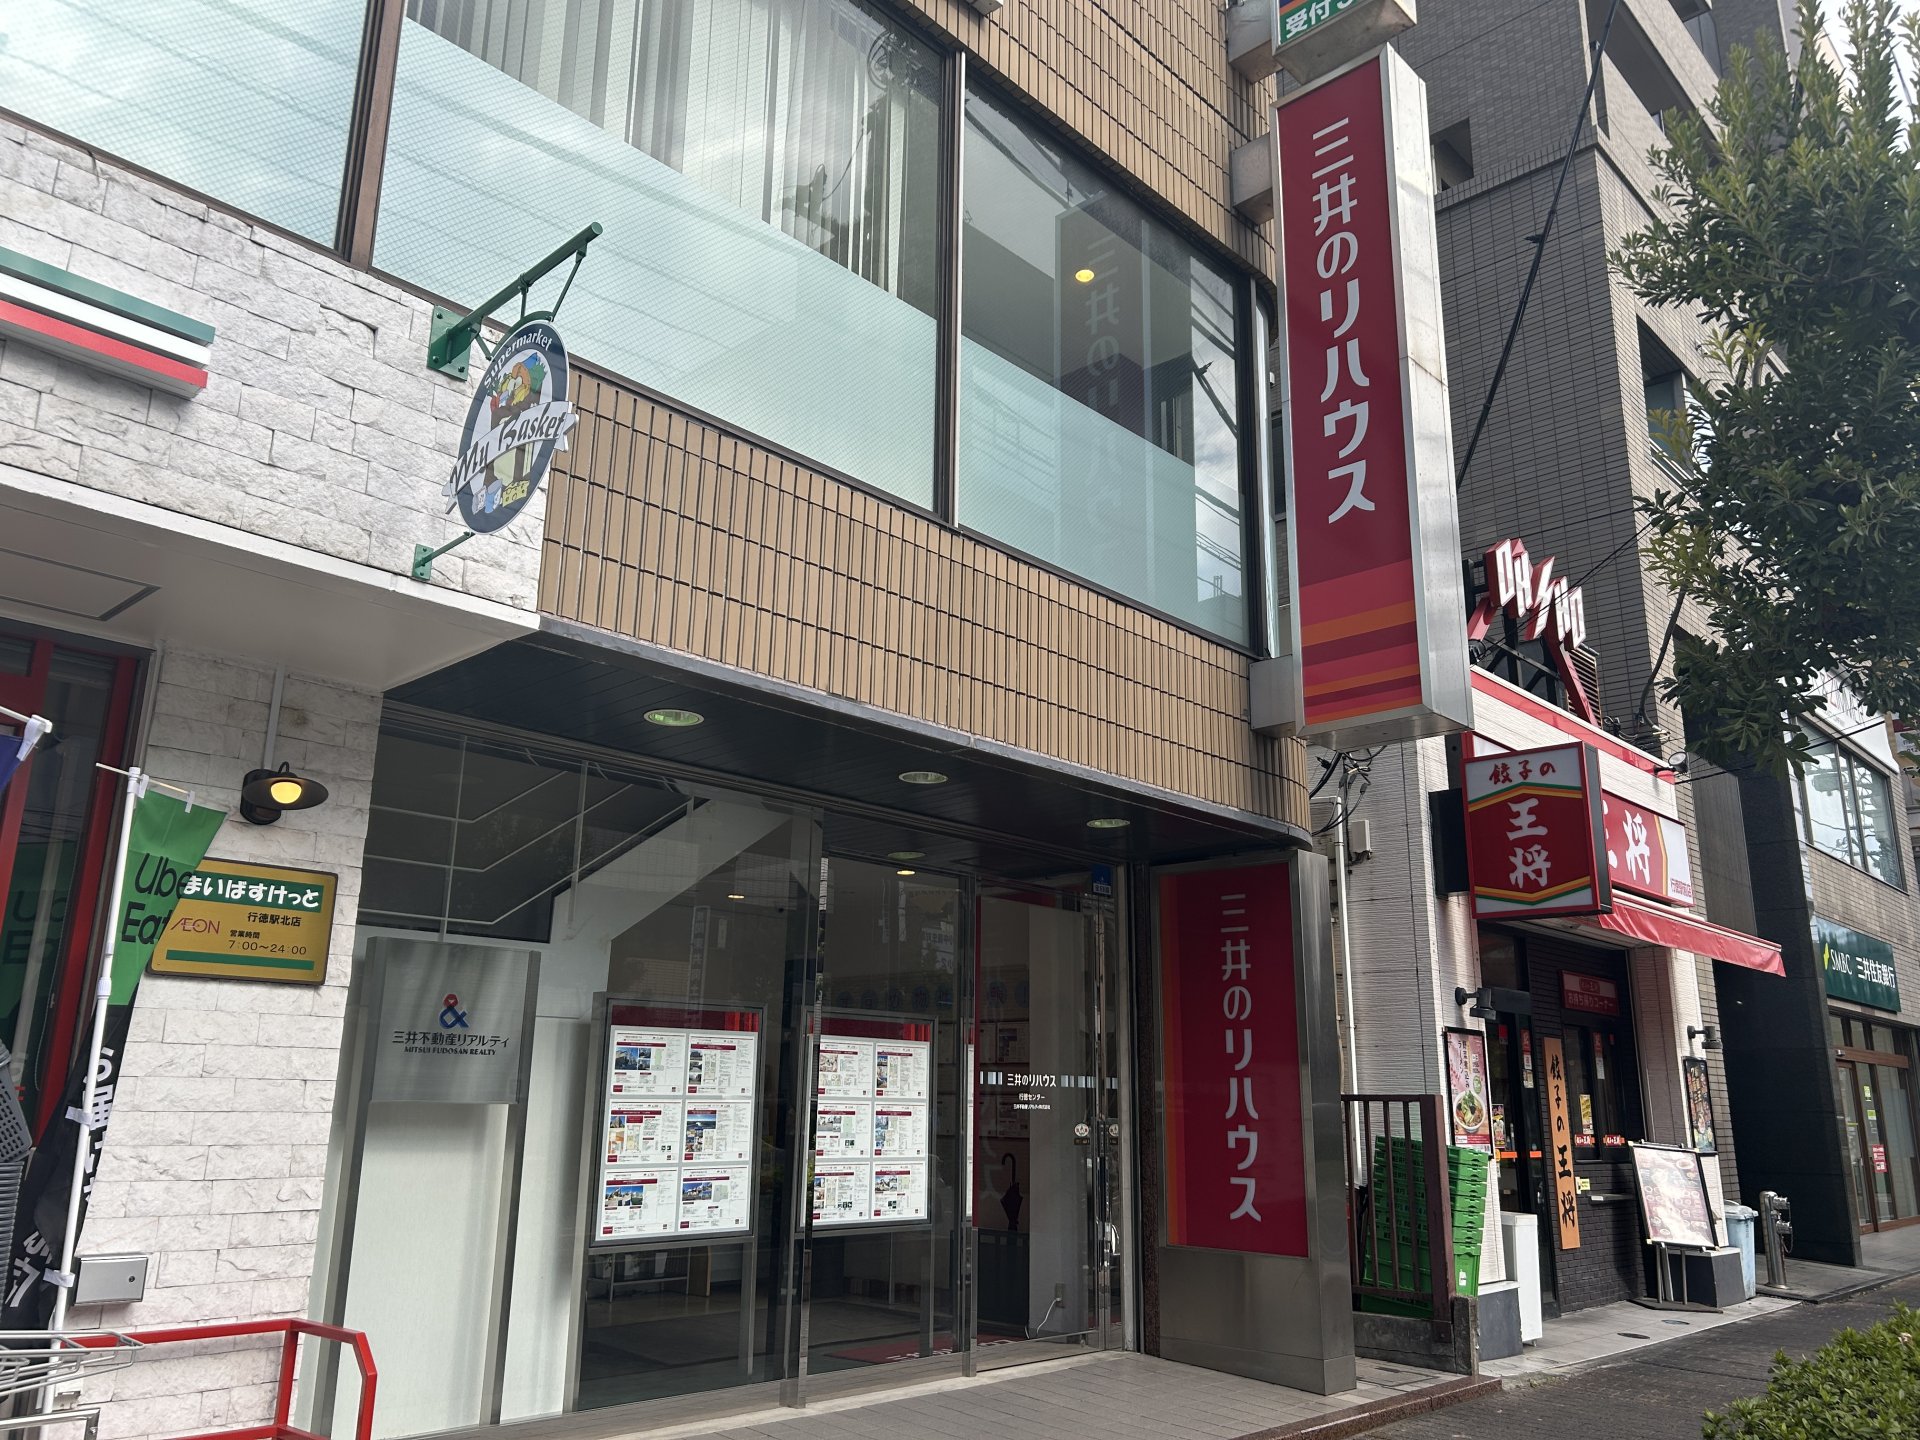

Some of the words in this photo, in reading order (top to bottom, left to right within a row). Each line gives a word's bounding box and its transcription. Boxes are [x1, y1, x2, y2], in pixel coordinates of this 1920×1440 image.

[1312, 117, 1375, 524] 三井のリハウス
[484, 328, 553, 389] Supermarket
[450, 440, 490, 492] My
[499, 401, 567, 451] Basket
[1489, 759, 1556, 785] 餃子の
[1506, 797, 1552, 889] 王将
[183, 875, 320, 908] まいばすけっと
[229, 929, 260, 939] 営業時間
[247, 911, 302, 927] 行徳駅北店
[1830, 949, 1853, 975] SMBC
[1856, 956, 1896, 989] 三井住友銀行
[392, 1031, 510, 1048] 三井不動産リアルティ
[404, 1046, 431, 1054] MITSUI
[432, 1046, 468, 1055] FUDOSAN
[469, 1048, 496, 1056] REALTY
[1220, 893, 1262, 1223] 三井のリハウス
[1007, 1073, 1057, 1088] 三井のリハウス
[1550, 1054, 1576, 1229] 餃子の王将
